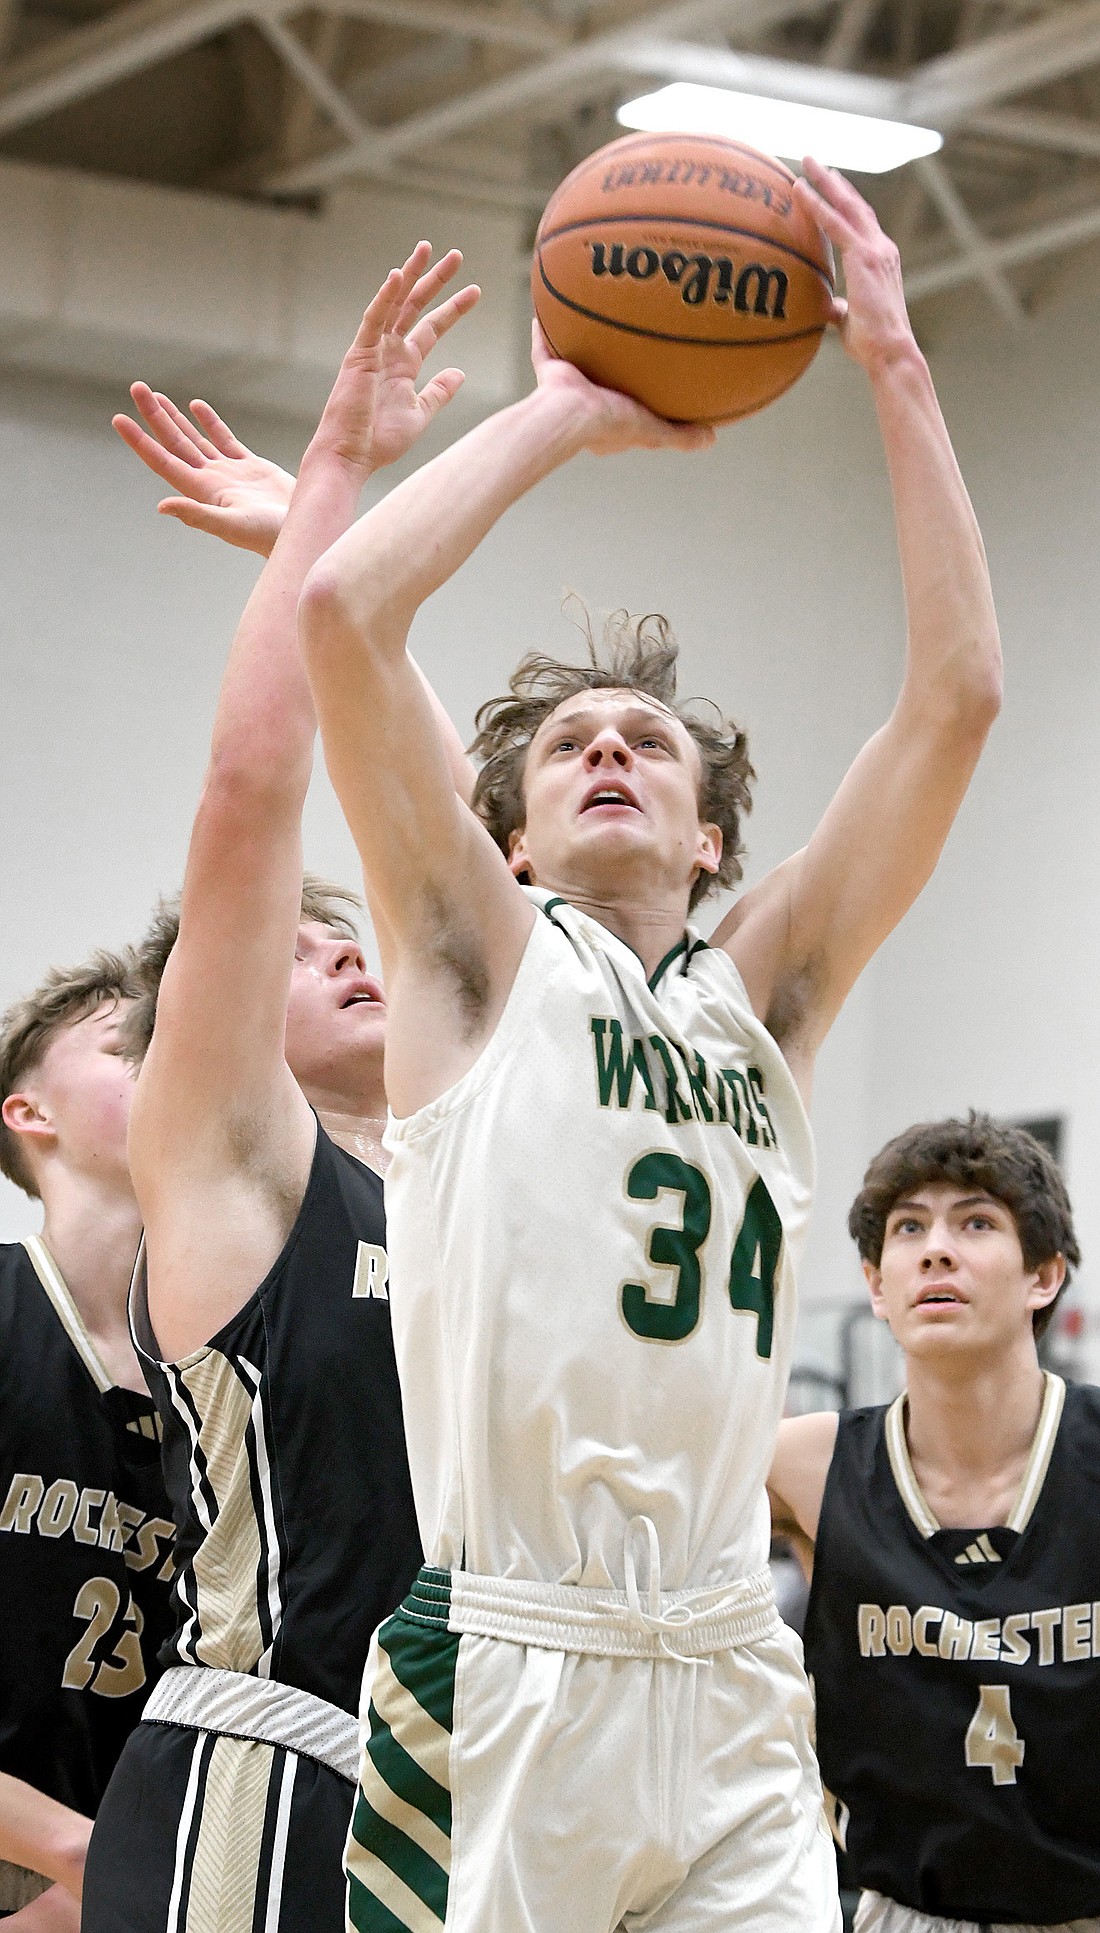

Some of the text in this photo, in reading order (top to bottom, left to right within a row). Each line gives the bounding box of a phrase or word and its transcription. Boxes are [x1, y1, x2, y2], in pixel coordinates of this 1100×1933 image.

[590, 241, 789, 320] Wilson
[617, 1147, 784, 1363] 34
[61, 1576, 147, 1698] 23
[965, 1684, 1025, 1785] 4
